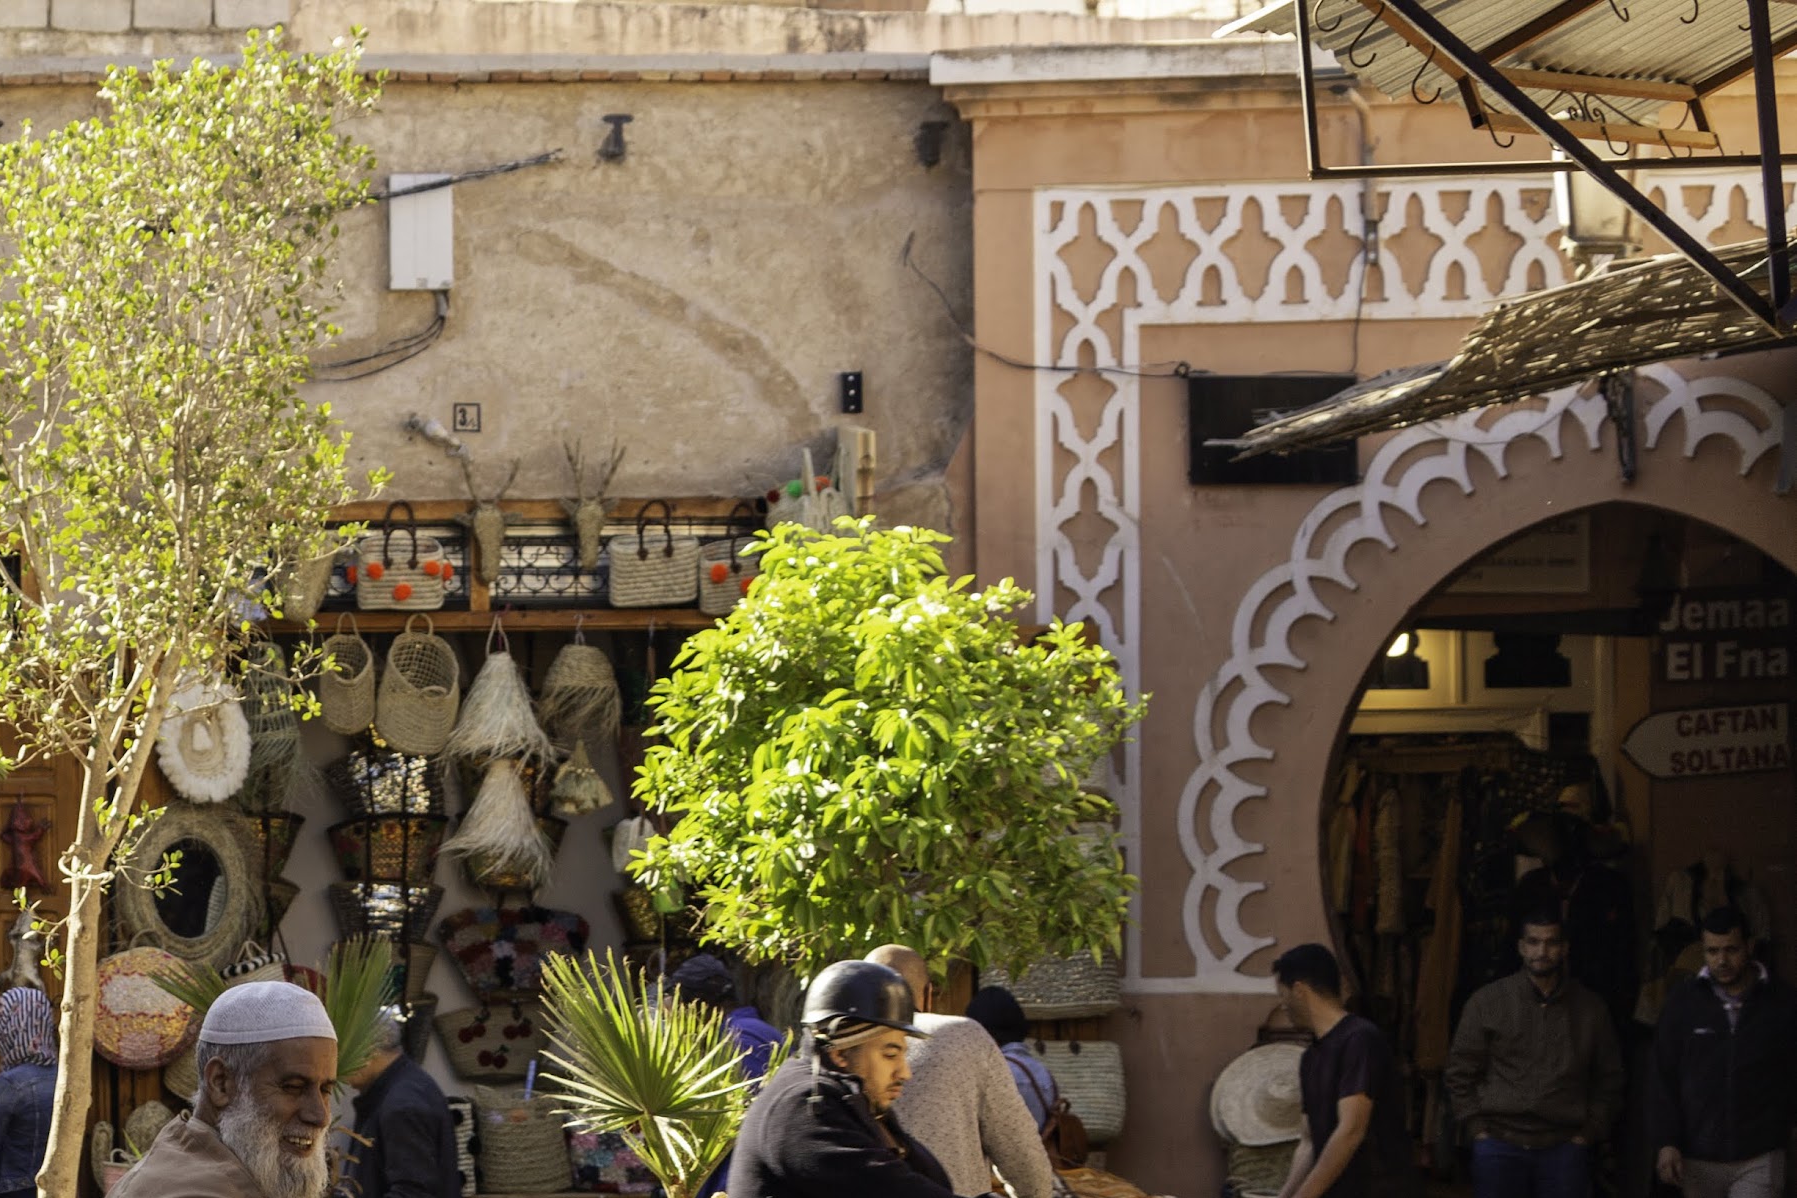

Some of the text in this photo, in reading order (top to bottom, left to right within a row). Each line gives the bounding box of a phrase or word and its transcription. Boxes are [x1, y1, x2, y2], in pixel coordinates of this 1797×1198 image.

[1659, 593, 1790, 632] Jemaa
[1666, 640, 1790, 681] El Fna
[1676, 707, 1779, 737] CAFTAN
[1669, 742, 1788, 774] SOLTANA
